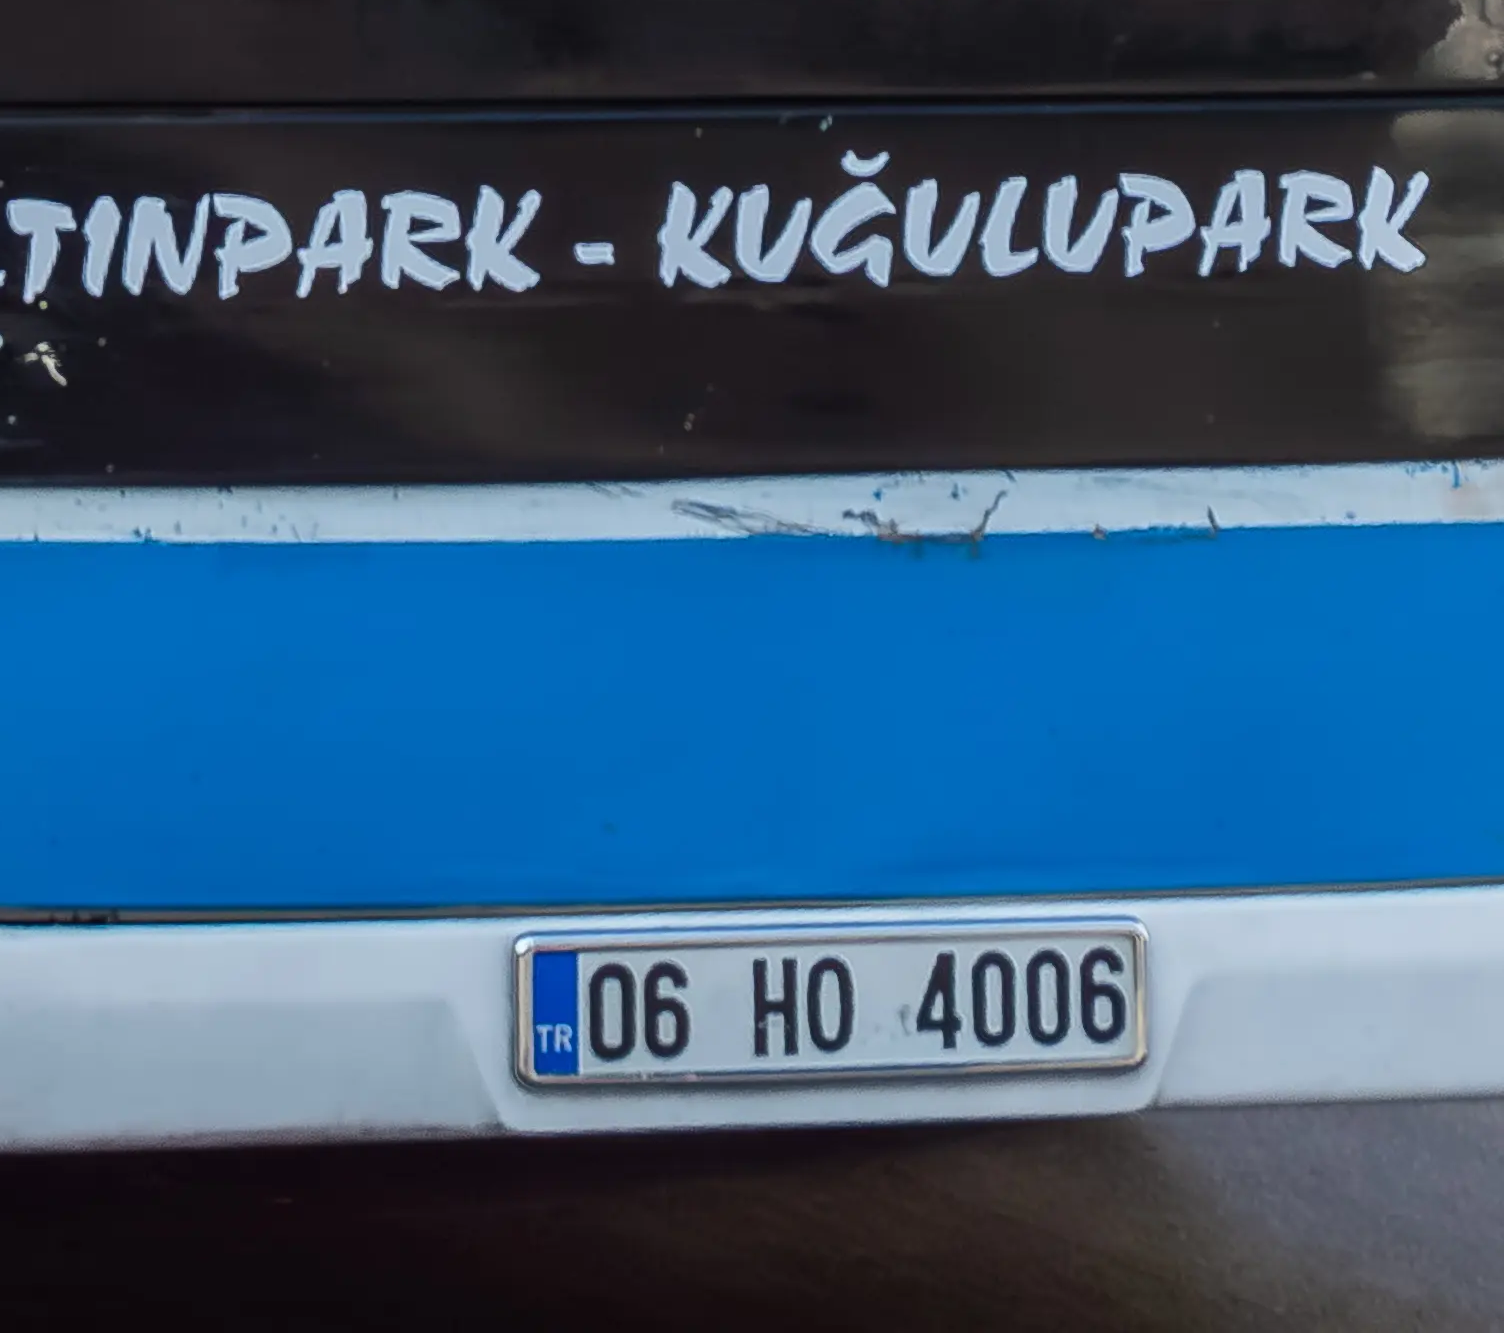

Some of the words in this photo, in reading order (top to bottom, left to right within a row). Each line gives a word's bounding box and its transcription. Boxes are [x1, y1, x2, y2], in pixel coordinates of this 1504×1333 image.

[656, 145, 1431, 293] KUĞULUPARK
[536, 1023, 573, 1054] TR
[588, 959, 690, 1061] 06
[751, 955, 855, 1057] HO
[915, 945, 1127, 1049] 4006
